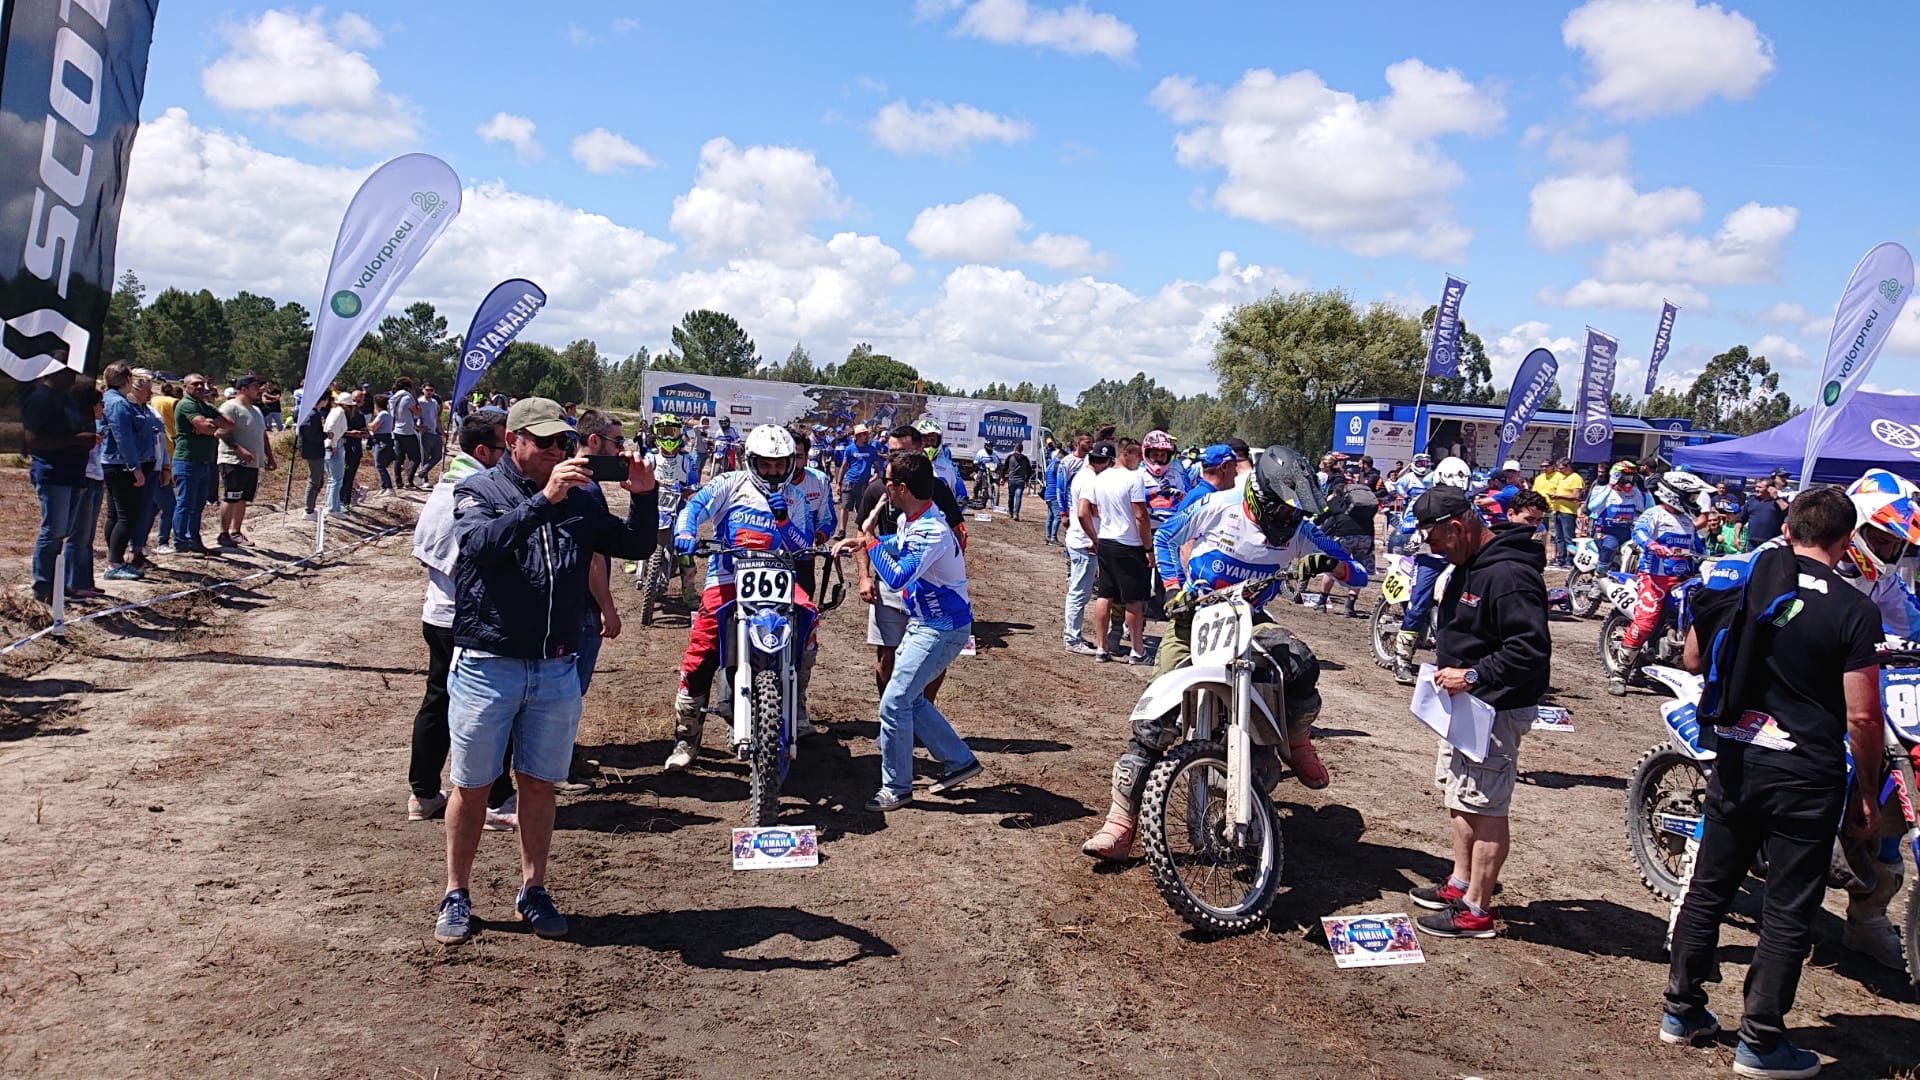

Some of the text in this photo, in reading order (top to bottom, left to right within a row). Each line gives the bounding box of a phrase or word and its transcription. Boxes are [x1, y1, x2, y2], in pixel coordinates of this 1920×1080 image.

[354, 220, 413, 289] valorpneu
[476, 293, 542, 353] YAMAHA
[1438, 287, 1460, 346] YAMAHA
[1839, 309, 1879, 378] valorpneu
[1511, 362, 1555, 424] YAMAHA
[1586, 344, 1611, 422] YAMAHA
[661, 400, 709, 414] YAMAHA
[985, 425, 1025, 438] YAMAHA
[744, 513, 778, 532] YAMAH
[741, 571, 788, 599] 869
[1385, 575, 1404, 599] 880
[1611, 588, 1635, 609] 898
[1197, 613, 1243, 656] 877
[1885, 684, 1920, 727] 8
[759, 839, 791, 848] YAMAHA
[1353, 930, 1389, 941] YAMAHA
